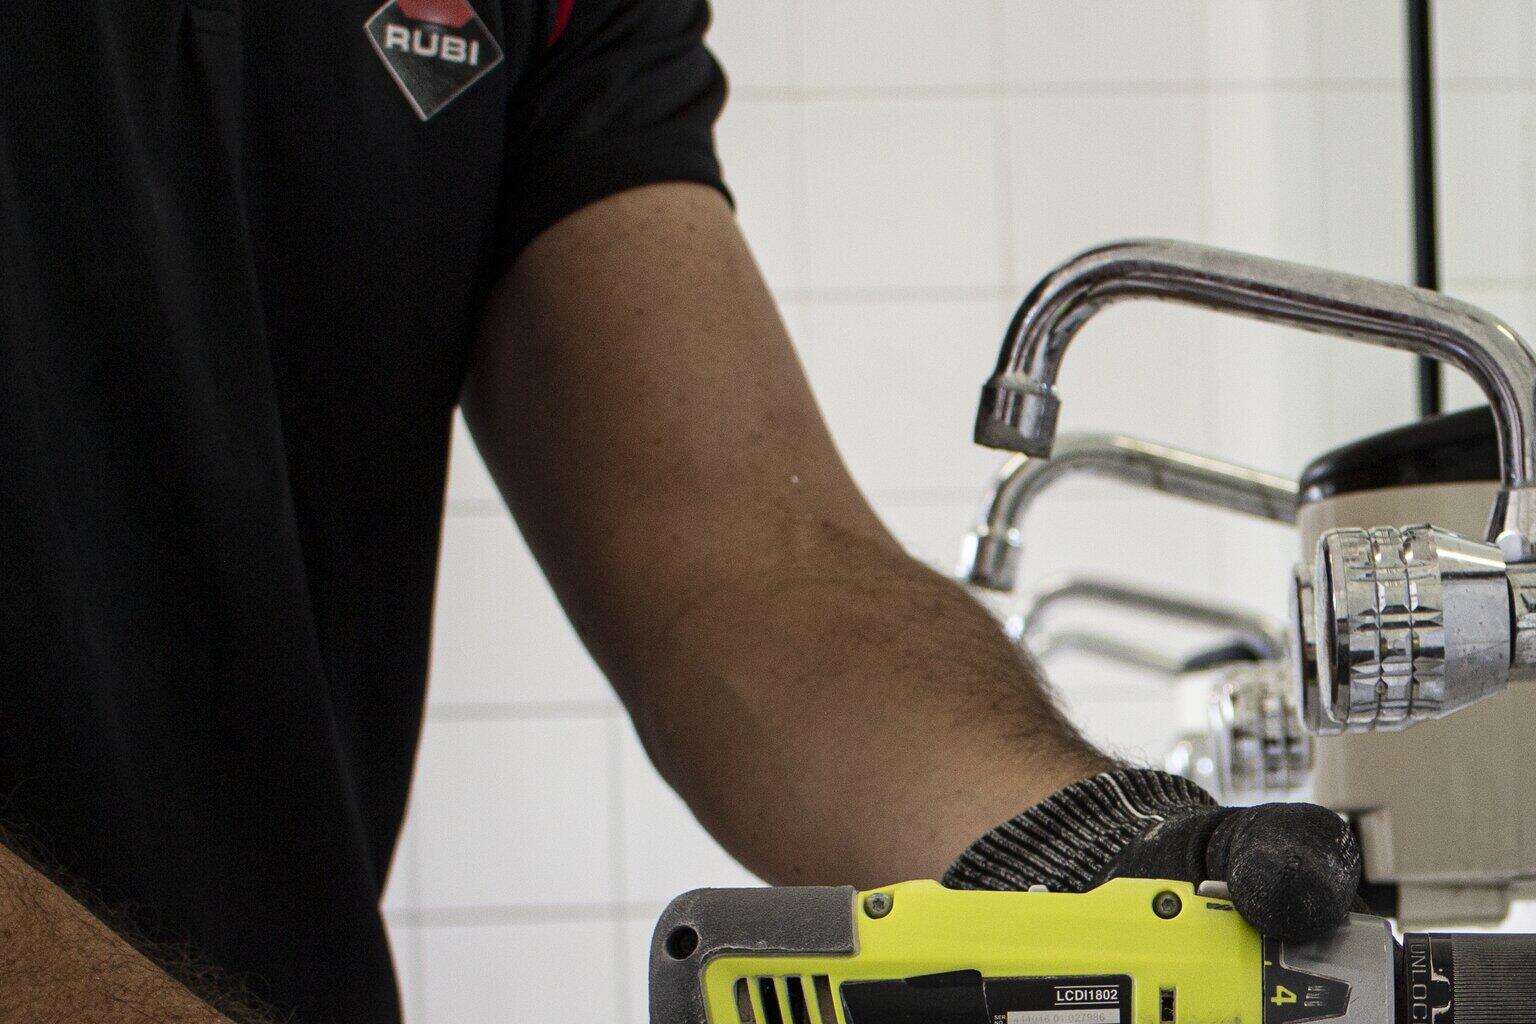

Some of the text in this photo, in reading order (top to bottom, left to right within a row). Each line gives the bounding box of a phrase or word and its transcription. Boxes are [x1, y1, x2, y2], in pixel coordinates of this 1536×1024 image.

[383, 23, 480, 66] RUBI
[1056, 988, 1118, 1002] LCDI1802
[1270, 985, 1298, 1006] 4
